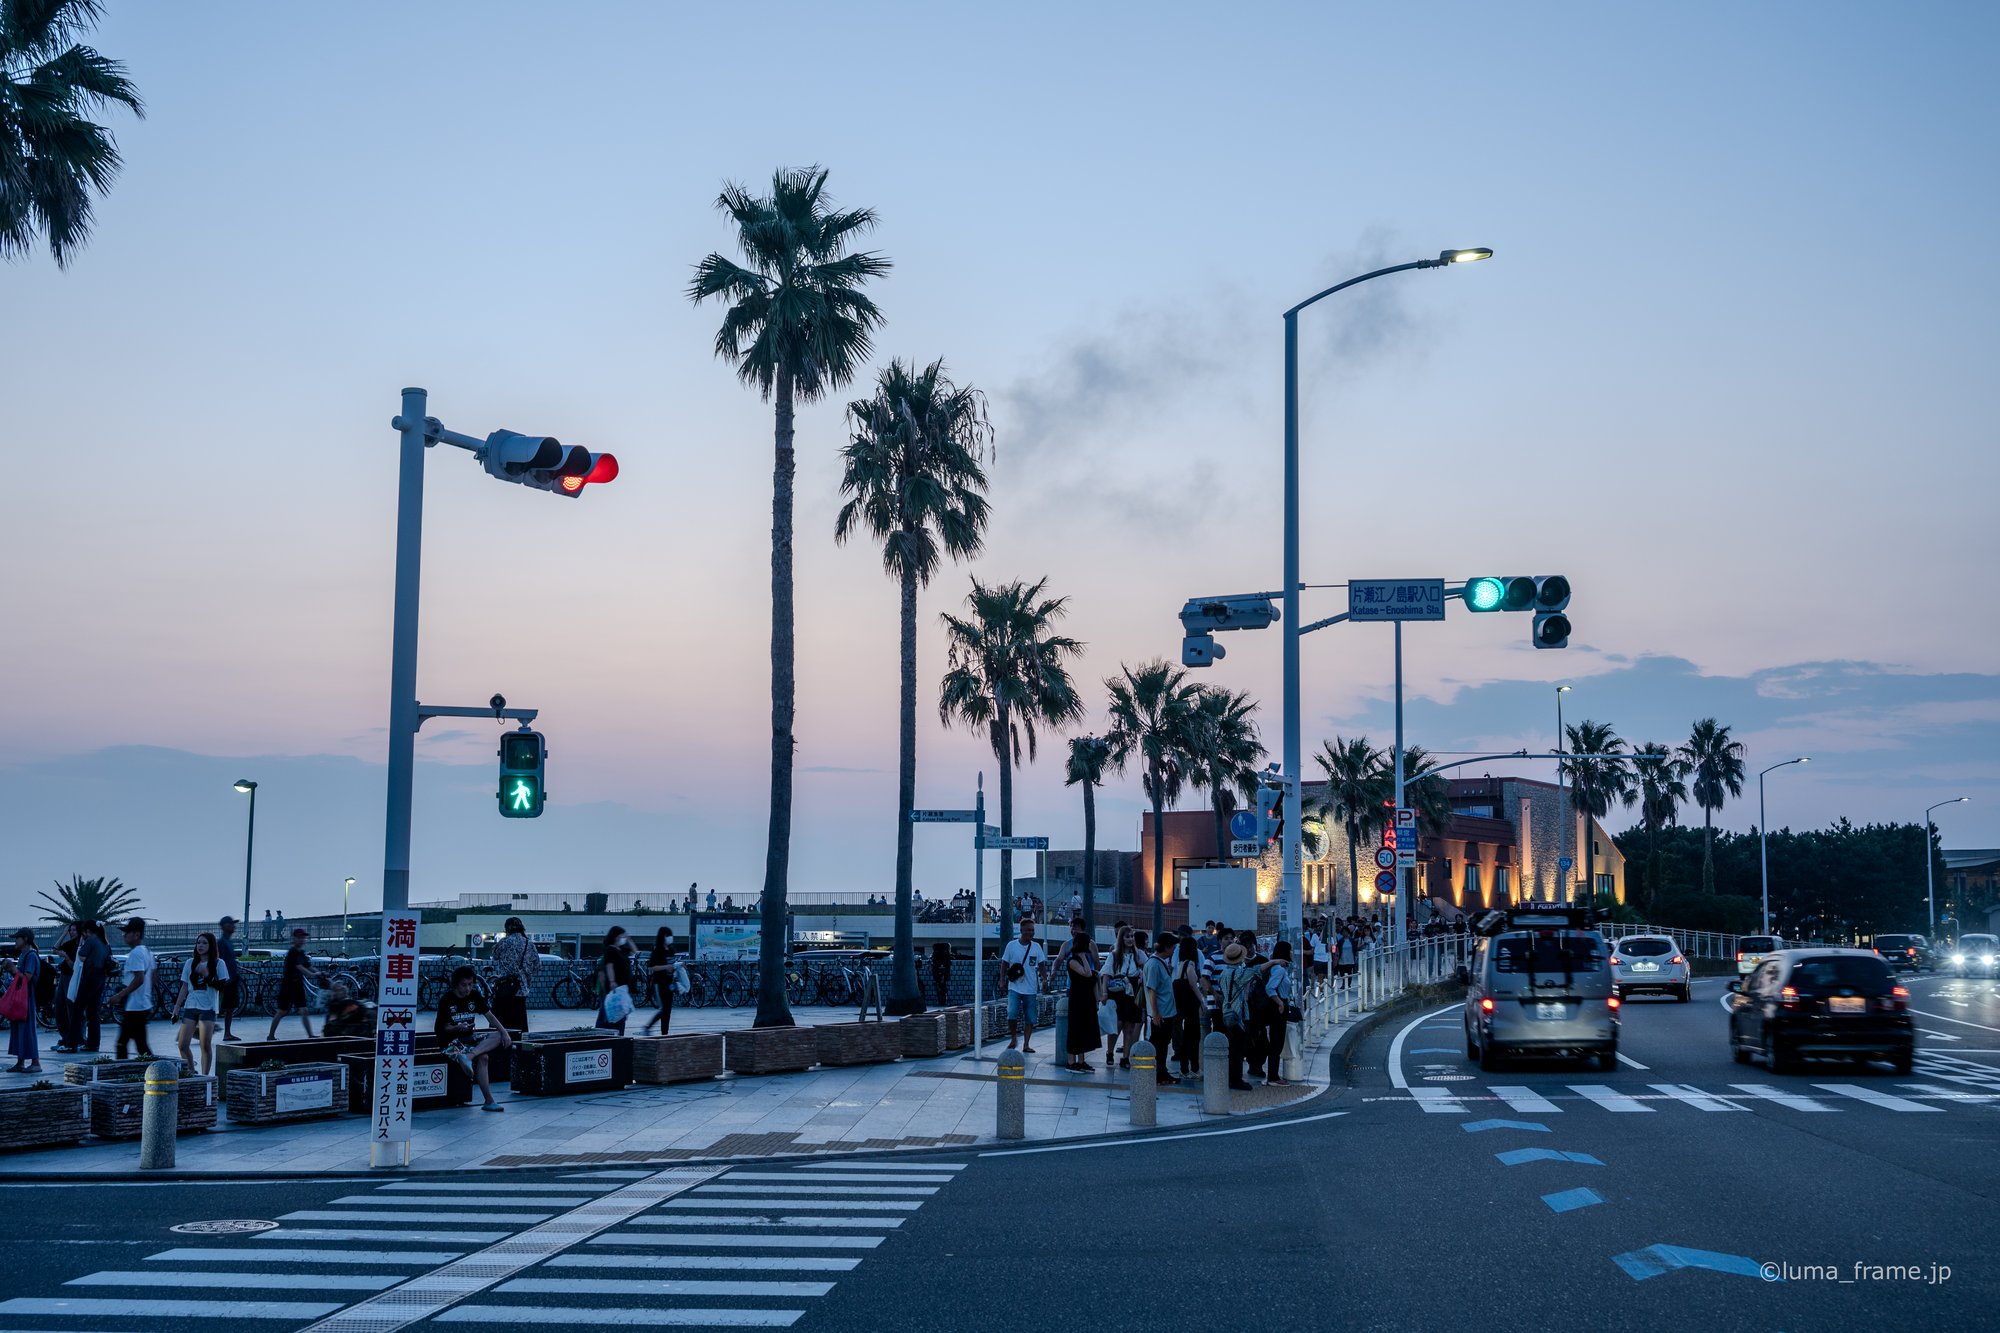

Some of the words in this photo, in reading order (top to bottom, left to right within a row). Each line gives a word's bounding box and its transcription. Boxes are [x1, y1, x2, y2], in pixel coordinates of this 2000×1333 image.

[1353, 586, 1440, 603] 片瀬江ノ島駅入口
[1426, 605, 1441, 615] Sta.
[1398, 811, 1413, 825] P
[1233, 843, 1257, 853] 歩行者優先
[1379, 852, 1393, 864] 50
[386, 918, 417, 983] 満車
[385, 986, 412, 996] FULL
[395, 1070, 408, 1122] 大型バス
[378, 1071, 392, 1139] マイクロバス
